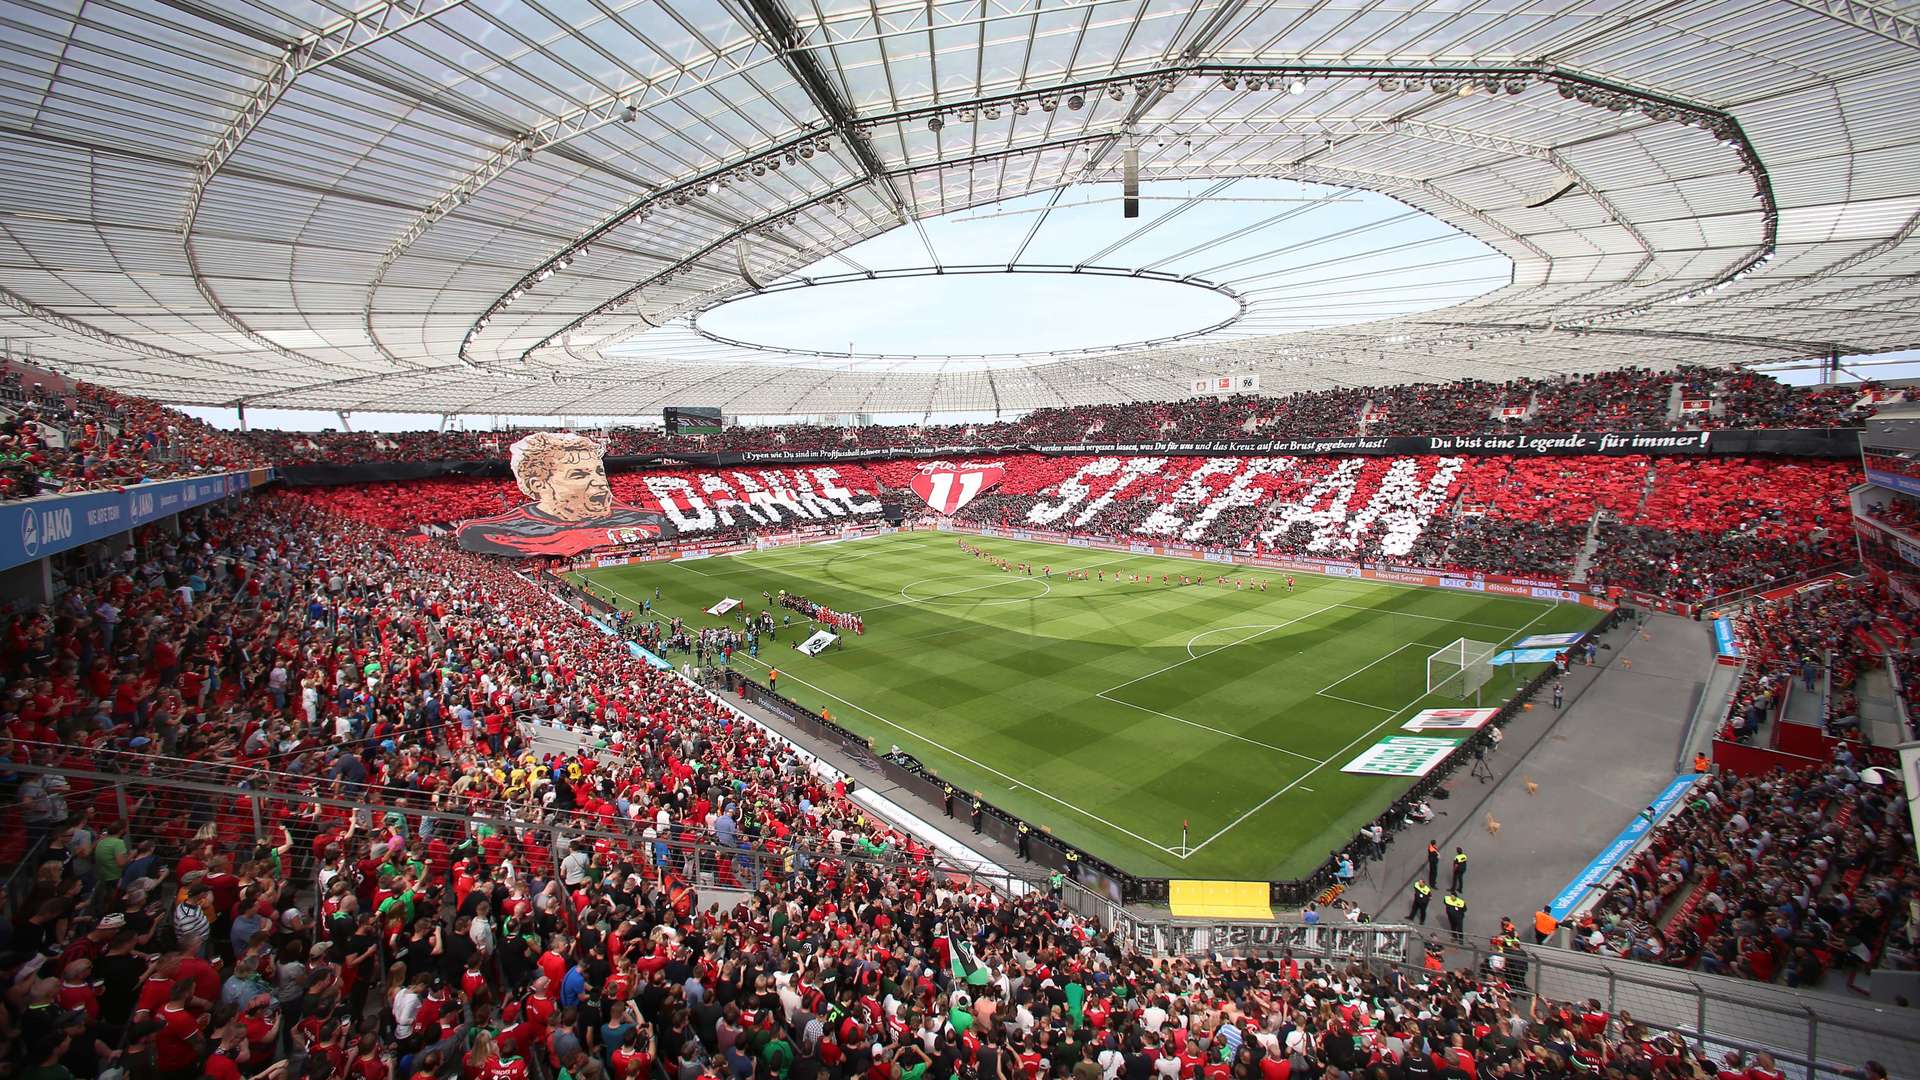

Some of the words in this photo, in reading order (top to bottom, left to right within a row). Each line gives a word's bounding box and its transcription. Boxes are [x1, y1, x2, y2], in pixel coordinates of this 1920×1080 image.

[1243, 379, 1253, 387] 96
[1062, 443, 1085, 451] niemals
[1086, 444, 1115, 454] vergessen
[1154, 441, 1167, 451] Du
[1165, 441, 1179, 452] für
[1195, 441, 1211, 450] und
[1212, 441, 1228, 451] das
[1229, 441, 1255, 451] Kreuz
[1256, 440, 1274, 452] auf
[1273, 440, 1289, 451] der
[1290, 440, 1316, 451] Brust
[1315, 439, 1357, 452] gegeben
[1357, 437, 1388, 448] hast!
[1430, 436, 1451, 449] Du
[1455, 436, 1482, 448] bist
[1484, 436, 1515, 448] eine
[1516, 433, 1586, 452] Legende
[1598, 433, 1630, 452] für
[795, 450, 809, 458] sind
[643, 467, 883, 532] DANKE
[927, 471, 984, 513] 11
[1026, 456, 1464, 556] STEFAN
[41, 507, 73, 545] JAKO
[1376, 571, 1401, 582] Hosted
[1444, 577, 1480, 590] DITCON
[1488, 582, 1528, 595] ditcon.de
[1534, 587, 1579, 602] DITCON
